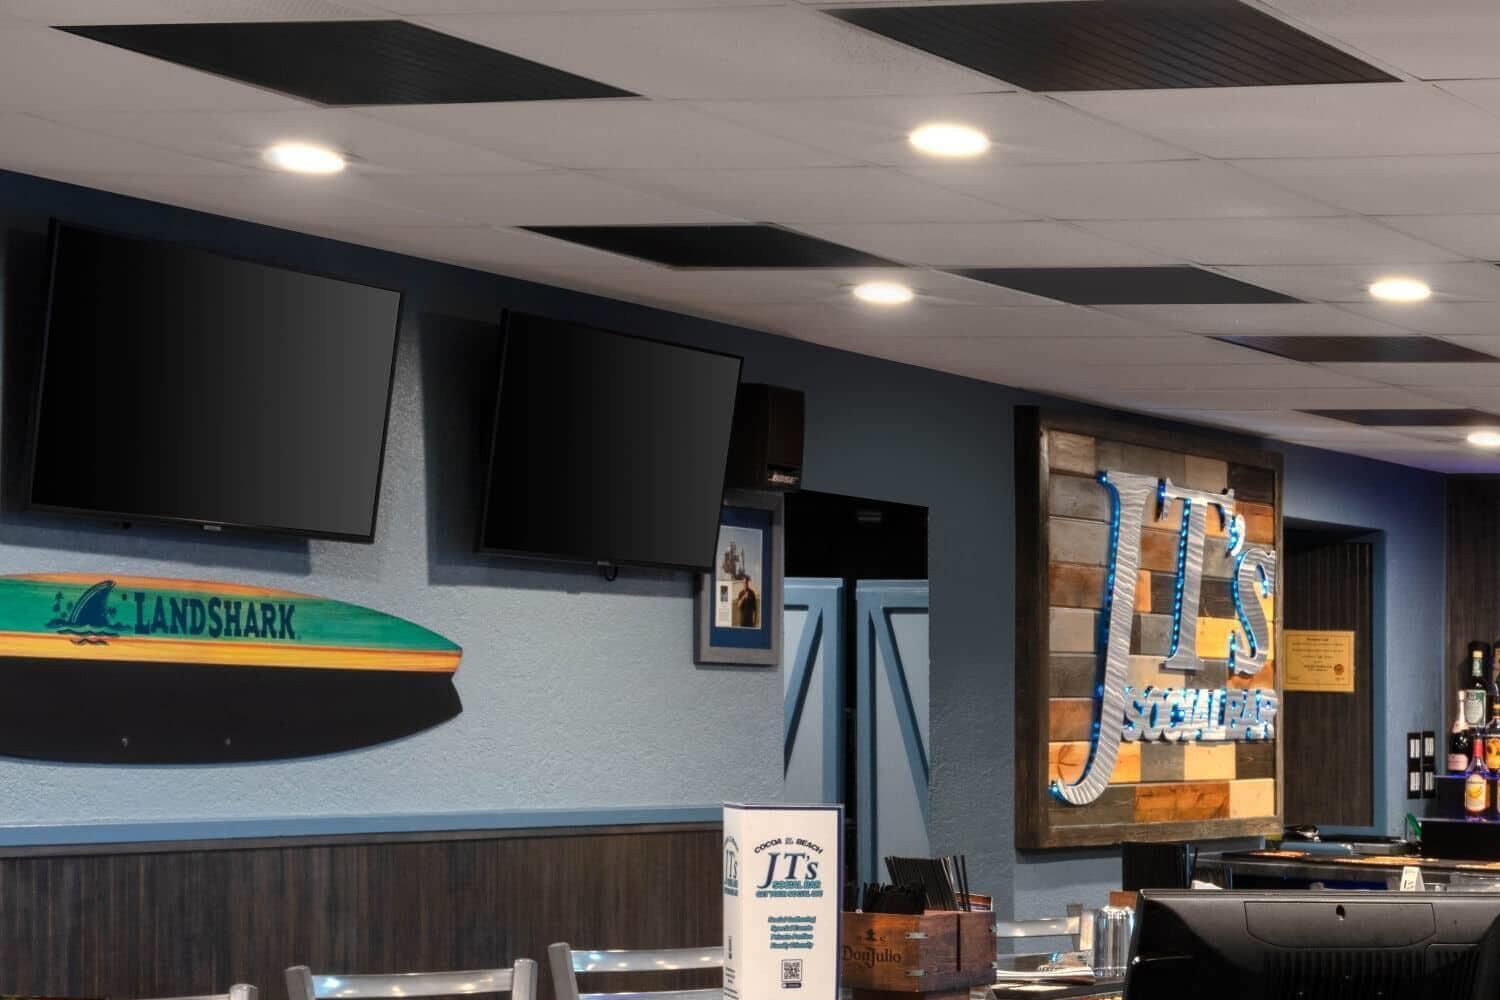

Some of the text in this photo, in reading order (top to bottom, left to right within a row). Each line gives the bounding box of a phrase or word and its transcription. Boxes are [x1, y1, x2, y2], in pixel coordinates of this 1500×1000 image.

[134, 592, 296, 640] LANDSHARK
[1121, 686, 1227, 741] SOCIAL
[754, 838, 782, 854] COCOA
[795, 838, 824, 854] BEACH
[757, 852, 819, 889] JT's
